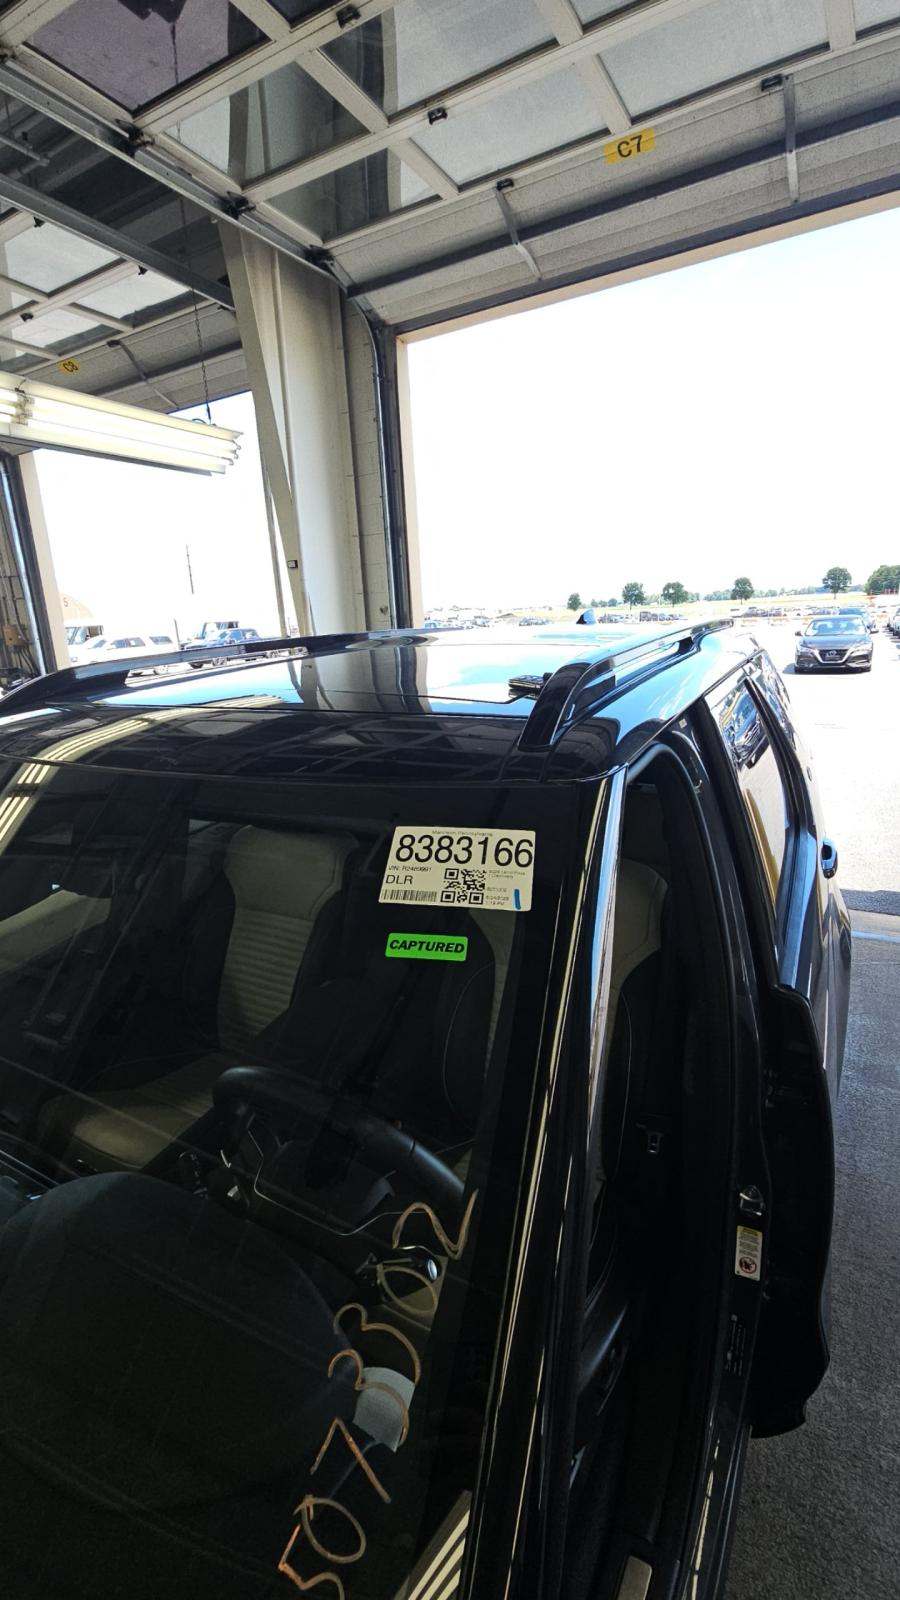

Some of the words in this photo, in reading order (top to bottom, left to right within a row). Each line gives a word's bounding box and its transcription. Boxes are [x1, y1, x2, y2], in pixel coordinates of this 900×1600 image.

[617, 135, 642, 157] C7
[395, 834, 534, 868] 8383166
[385, 874, 414, 885] DLR
[389, 939, 465, 954] CAPTURED
